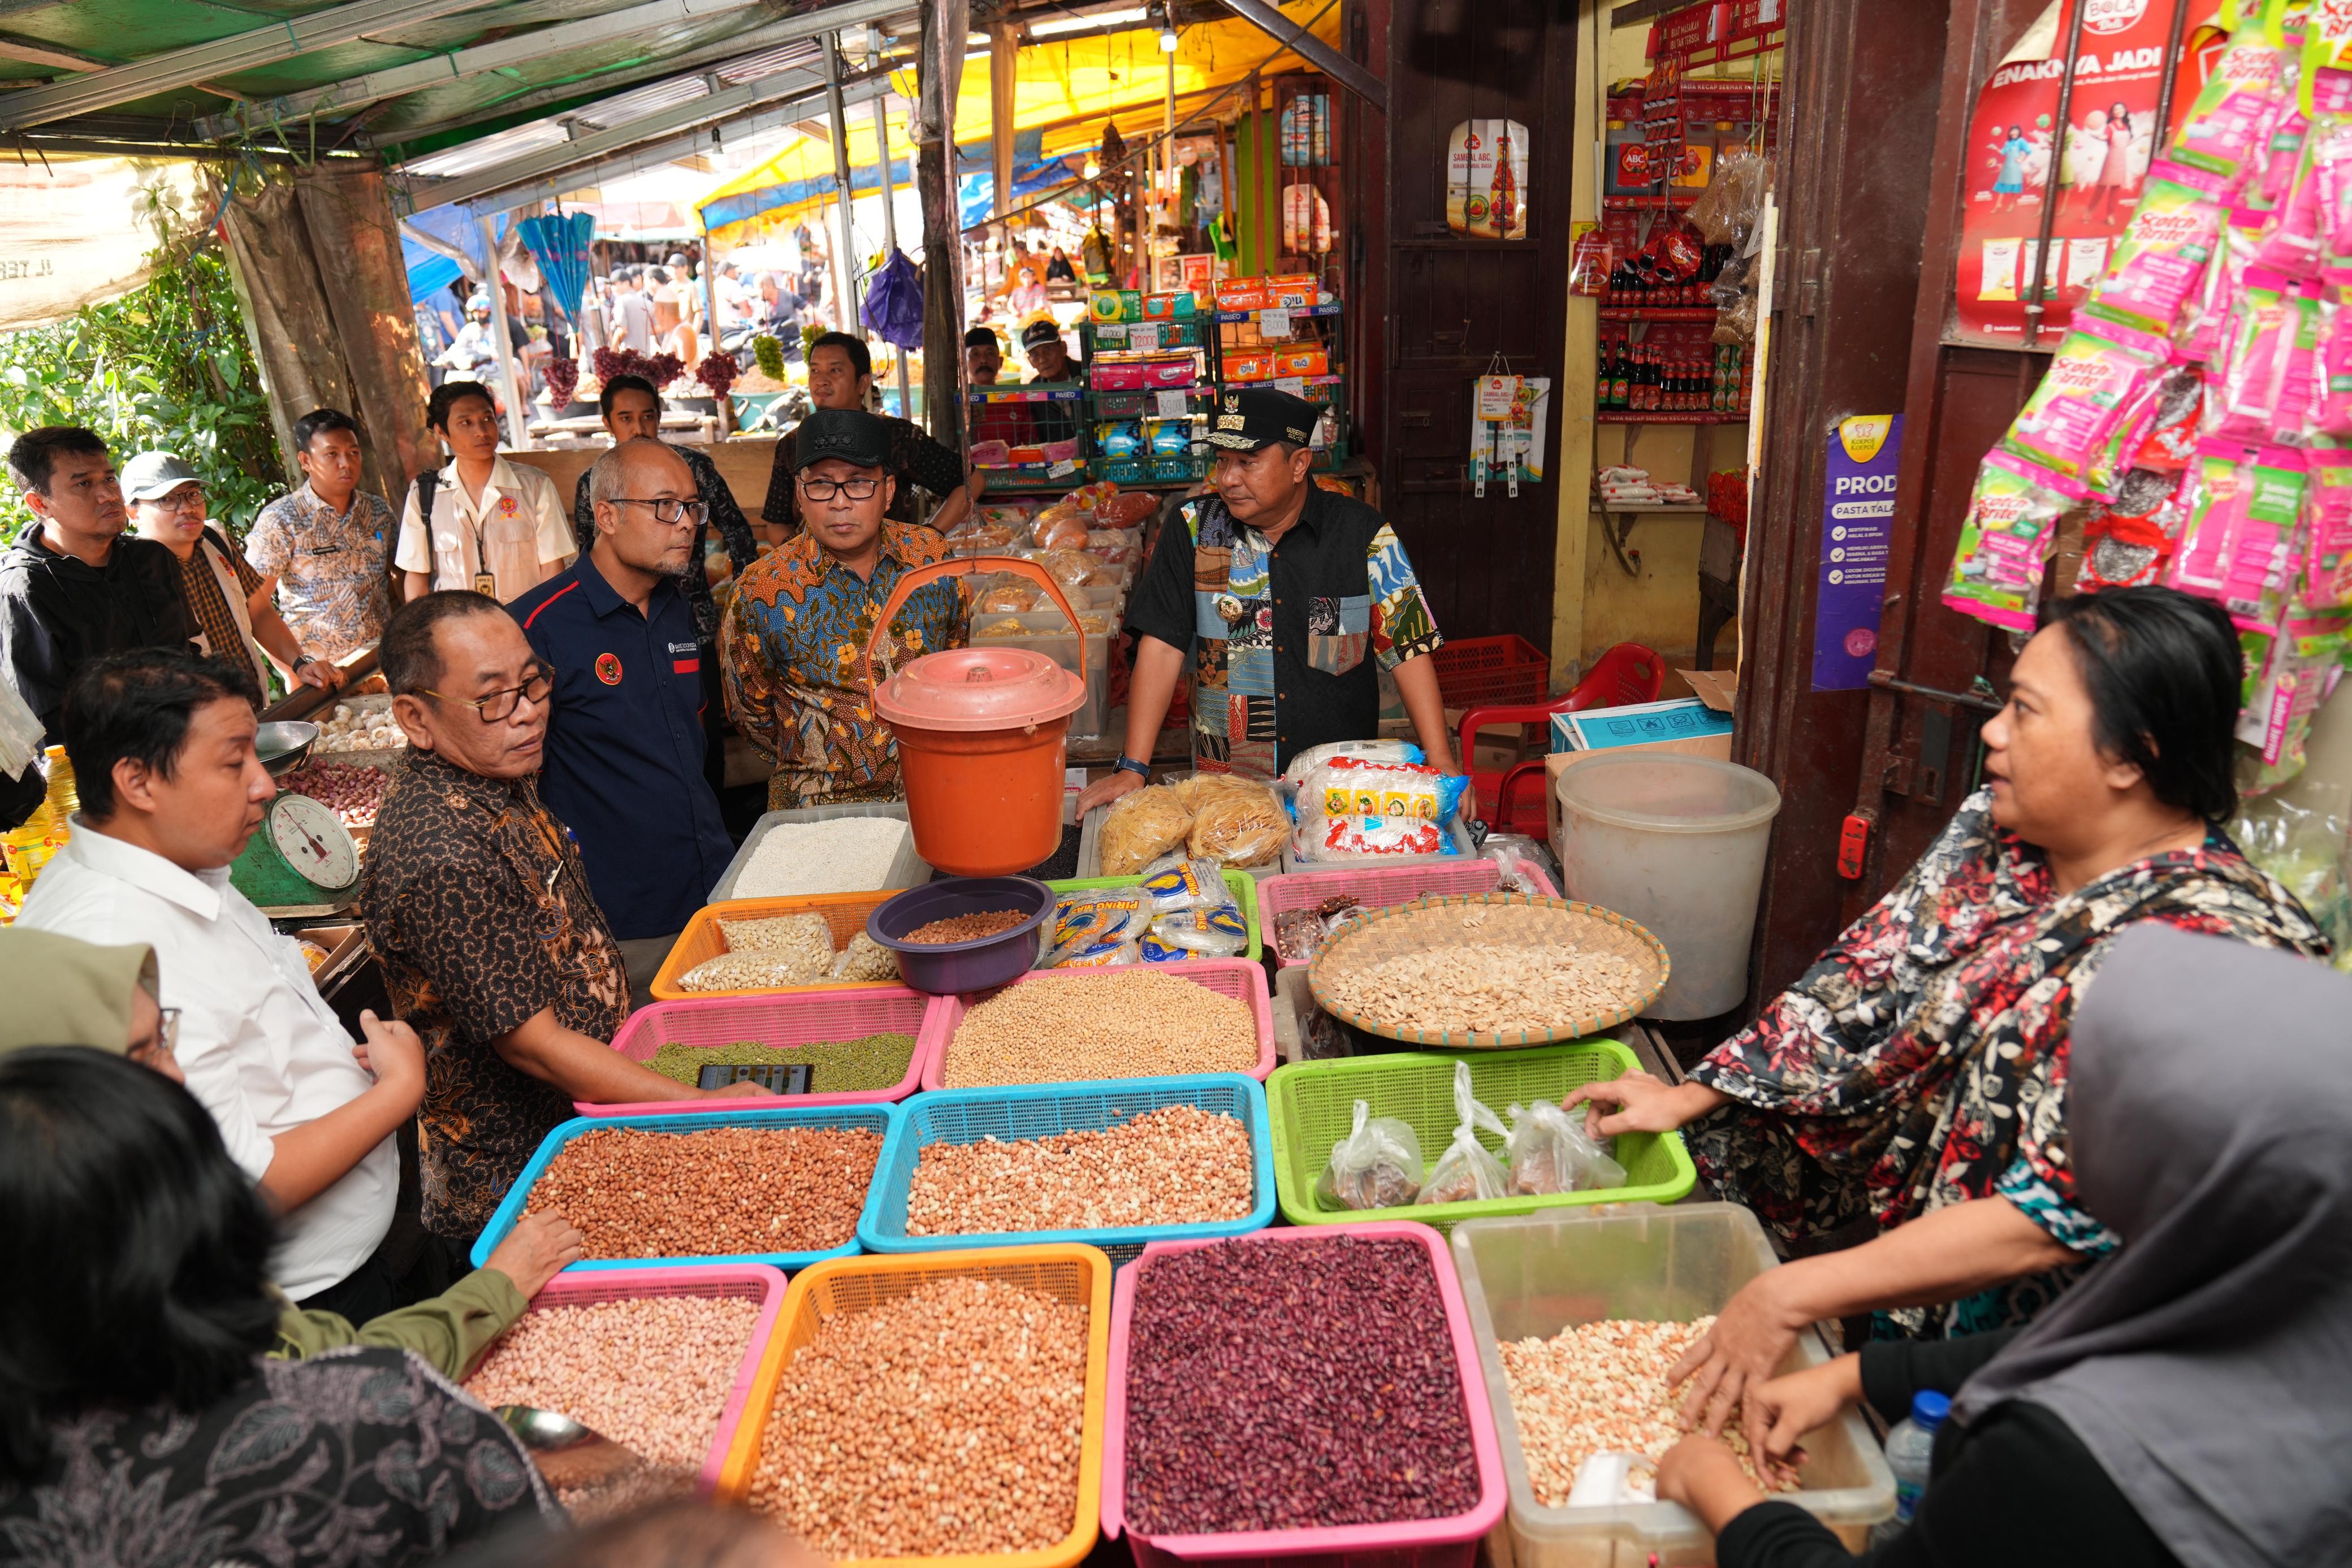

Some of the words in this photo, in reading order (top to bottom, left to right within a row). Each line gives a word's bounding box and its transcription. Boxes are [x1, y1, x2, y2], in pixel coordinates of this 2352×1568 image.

[1745, 3, 1757, 14] BUAT
[1671, 28, 1680, 37] BUAT
[1680, 20, 1700, 33] MASAKAN
[1743, 17, 1752, 28] IBU
[1685, 33, 1700, 46] TERSISA
[2105, 46, 2163, 72] JADI
[2139, 212, 2198, 229] Scotch
[2055, 357, 2111, 376] Scotch
[1286, 426, 1308, 439] GUBERNUR
[1836, 505, 1869, 516] PASTA
